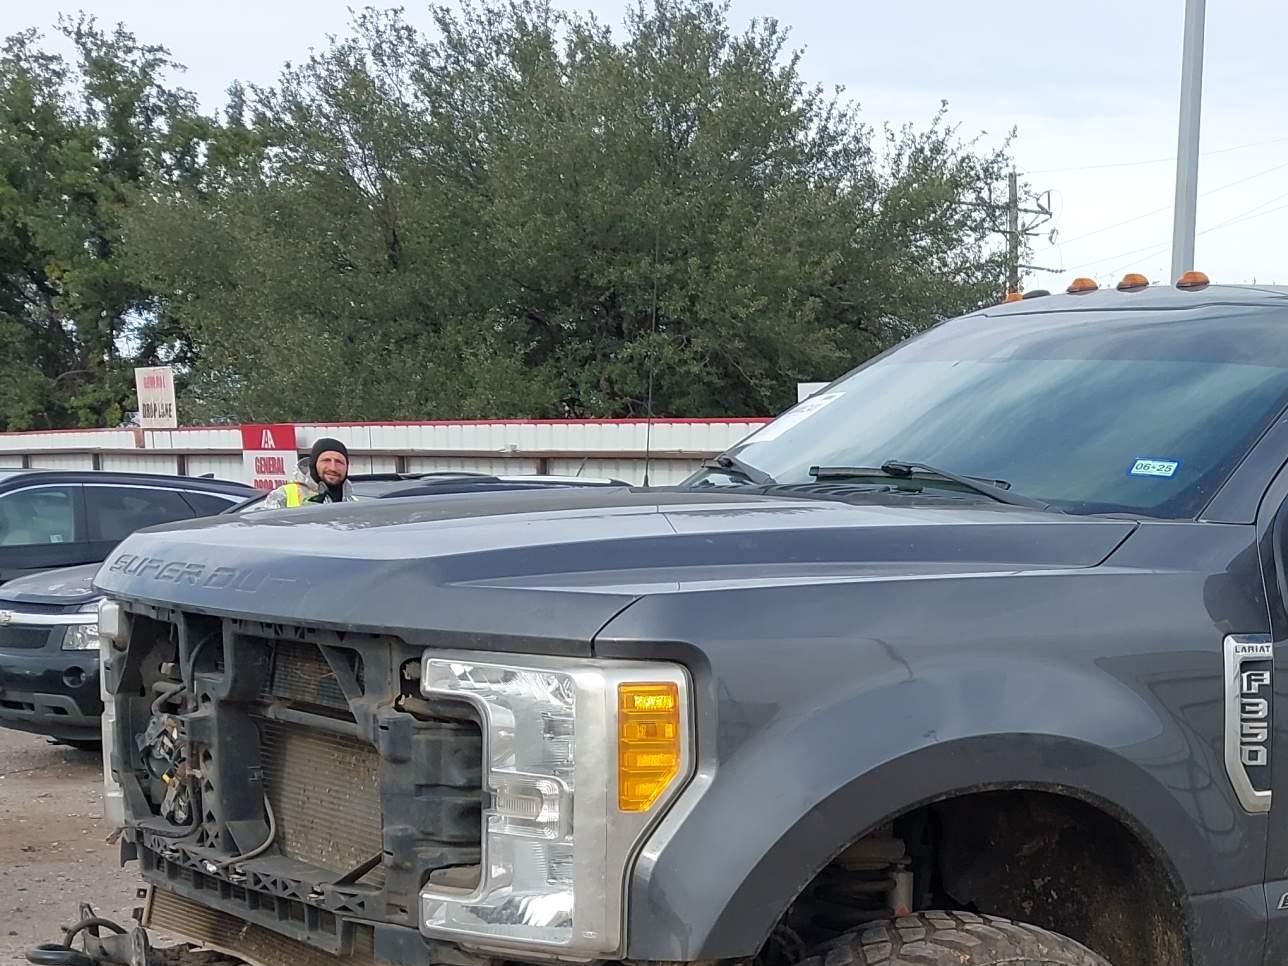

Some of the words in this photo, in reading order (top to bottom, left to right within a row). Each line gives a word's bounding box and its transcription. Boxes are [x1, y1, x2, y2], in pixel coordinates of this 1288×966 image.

[254, 456, 286, 475] GENERAL
[108, 553, 206, 585] SUPER
[1234, 644, 1271, 654] LARIAT
